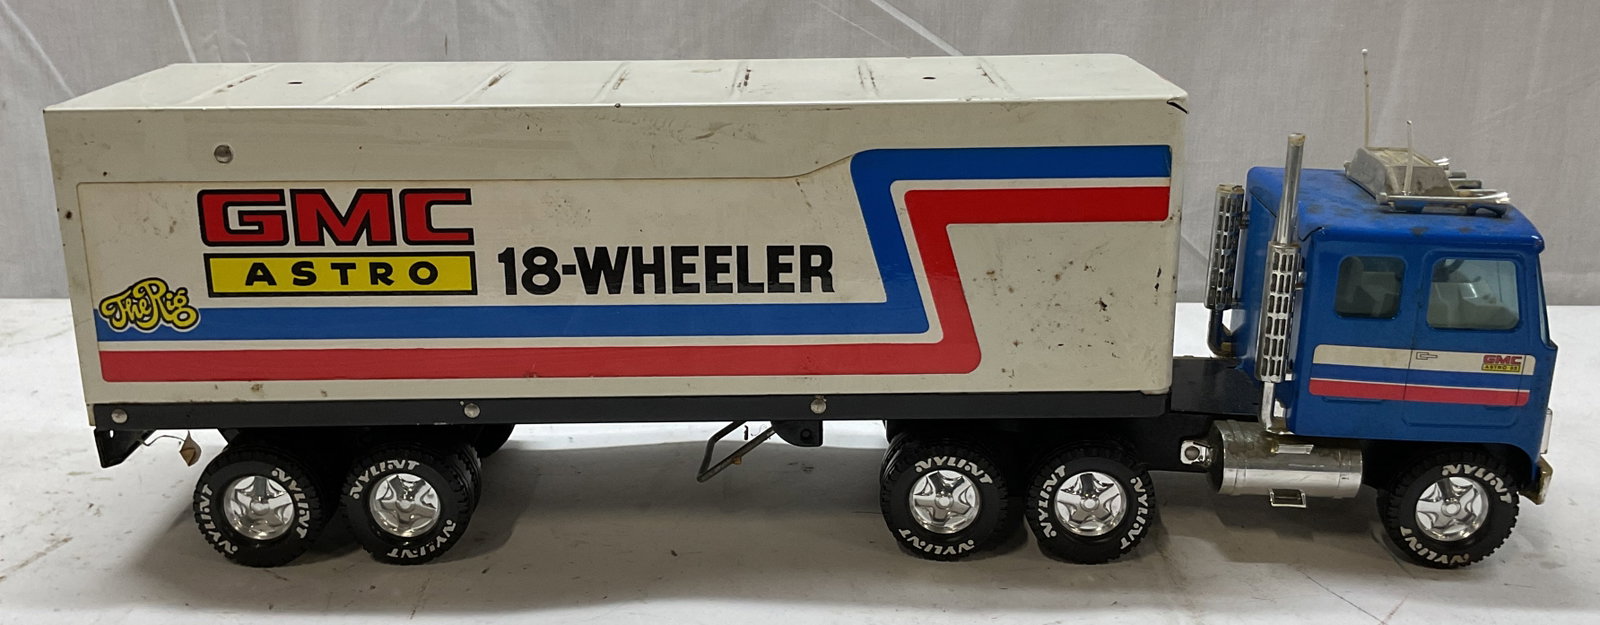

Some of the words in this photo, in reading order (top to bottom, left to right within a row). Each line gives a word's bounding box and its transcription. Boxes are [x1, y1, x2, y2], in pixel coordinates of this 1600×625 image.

[197, 188, 475, 247] GMC
[245, 261, 439, 287] ASTRO
[497, 245, 836, 296] 18-WHEELER
[99, 286, 152, 330] The
[132, 277, 199, 330] Rig
[1483, 354, 1522, 365] GMC
[350, 460, 420, 499] NYLINT
[915, 456, 993, 484] NYLINT
[1442, 464, 1512, 504] NYLINT
[199, 484, 238, 555] NYLINT
[271, 467, 310, 539] NYLINT
[1038, 465, 1066, 538] NYLINT
[1120, 477, 1149, 549] NYLINT
[898, 528, 975, 555] NYLINT
[1400, 526, 1470, 566] NYLINT
